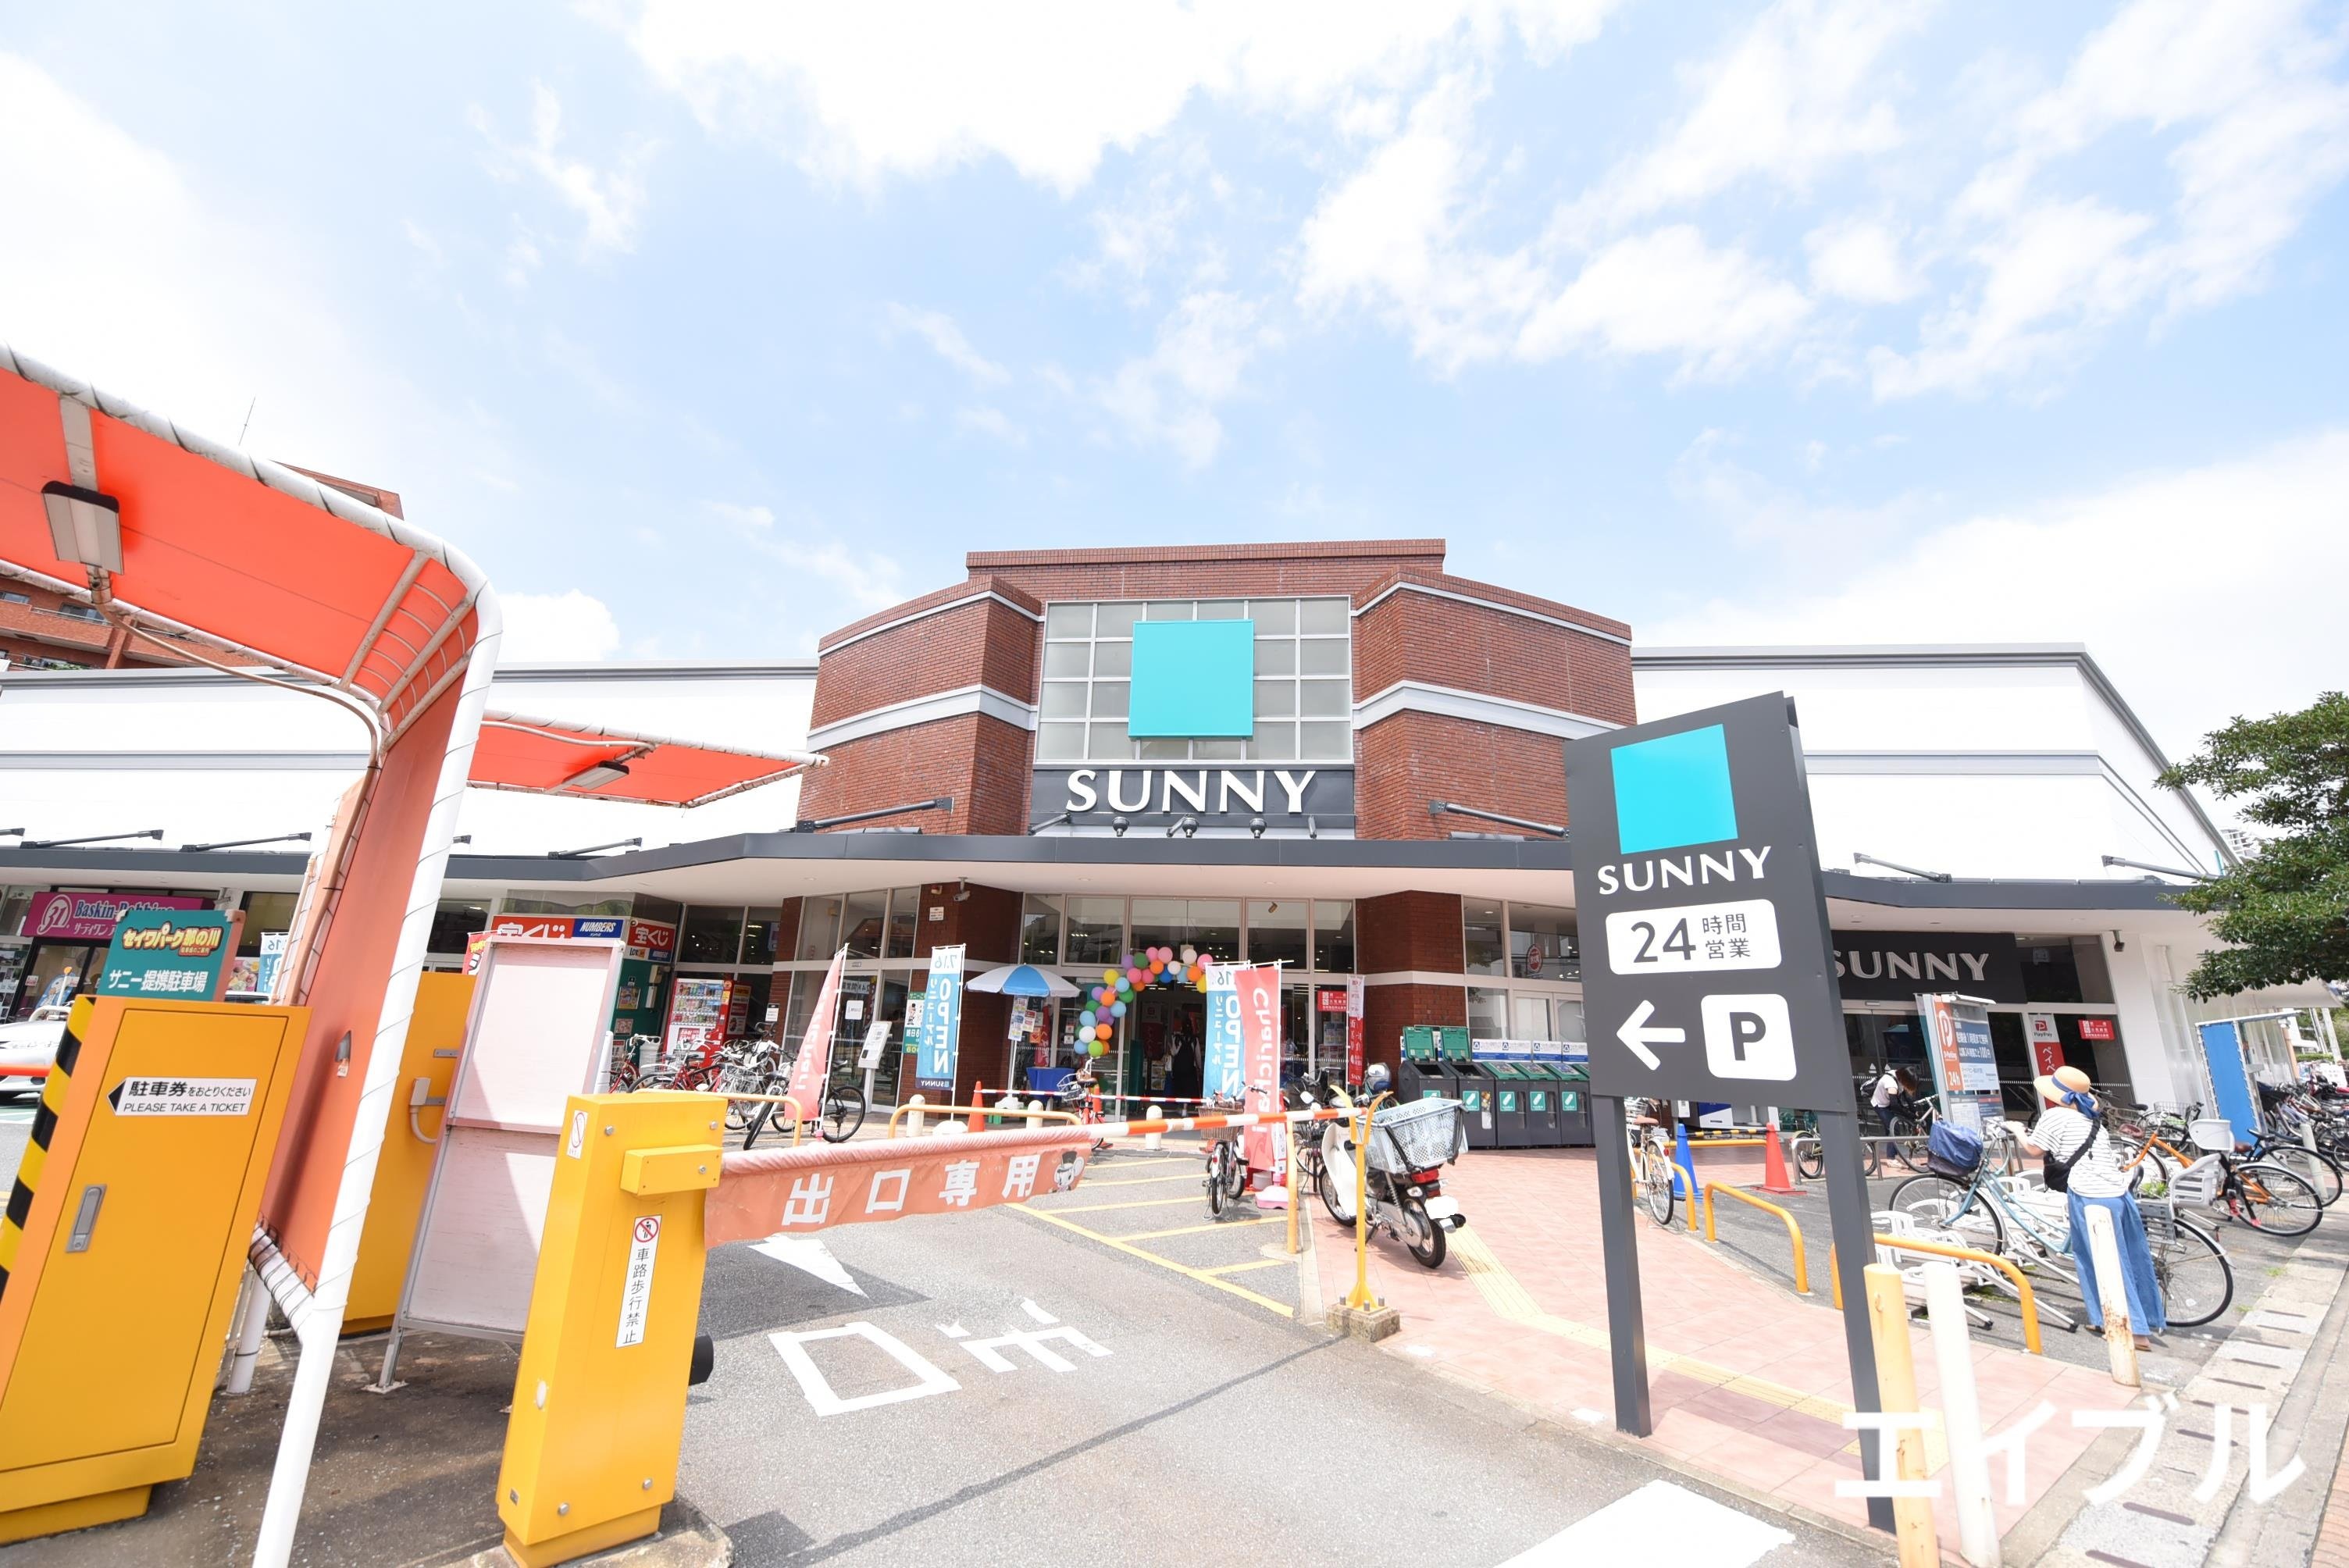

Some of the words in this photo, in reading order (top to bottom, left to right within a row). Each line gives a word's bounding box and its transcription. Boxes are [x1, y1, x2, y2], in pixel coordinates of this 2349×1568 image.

[1066, 769, 1316, 813] SUNNY
[1598, 846, 1771, 894] SUNNY
[579, 921, 616, 932] NUMBERS
[1702, 913, 1747, 935] 時間
[634, 927, 668, 946] 宝くじ
[1631, 918, 1696, 964] 24
[1705, 938, 1751, 960] 営業
[109, 970, 209, 992] サニー提携駐車場
[1729, 1012, 1766, 1061] P
[2042, 1046, 2056, 1072] ペイペ
[128, 1081, 251, 1097] 駐車券をおとりください
[123, 1103, 167, 1112] PLEASE
[170, 1103, 197, 1112] TAKE
[198, 1103, 207, 1112] A
[210, 1103, 246, 1112] TICKET
[782, 1153, 1042, 1227] 出口専用
[622, 1247, 650, 1345] 車路歩行禁止
